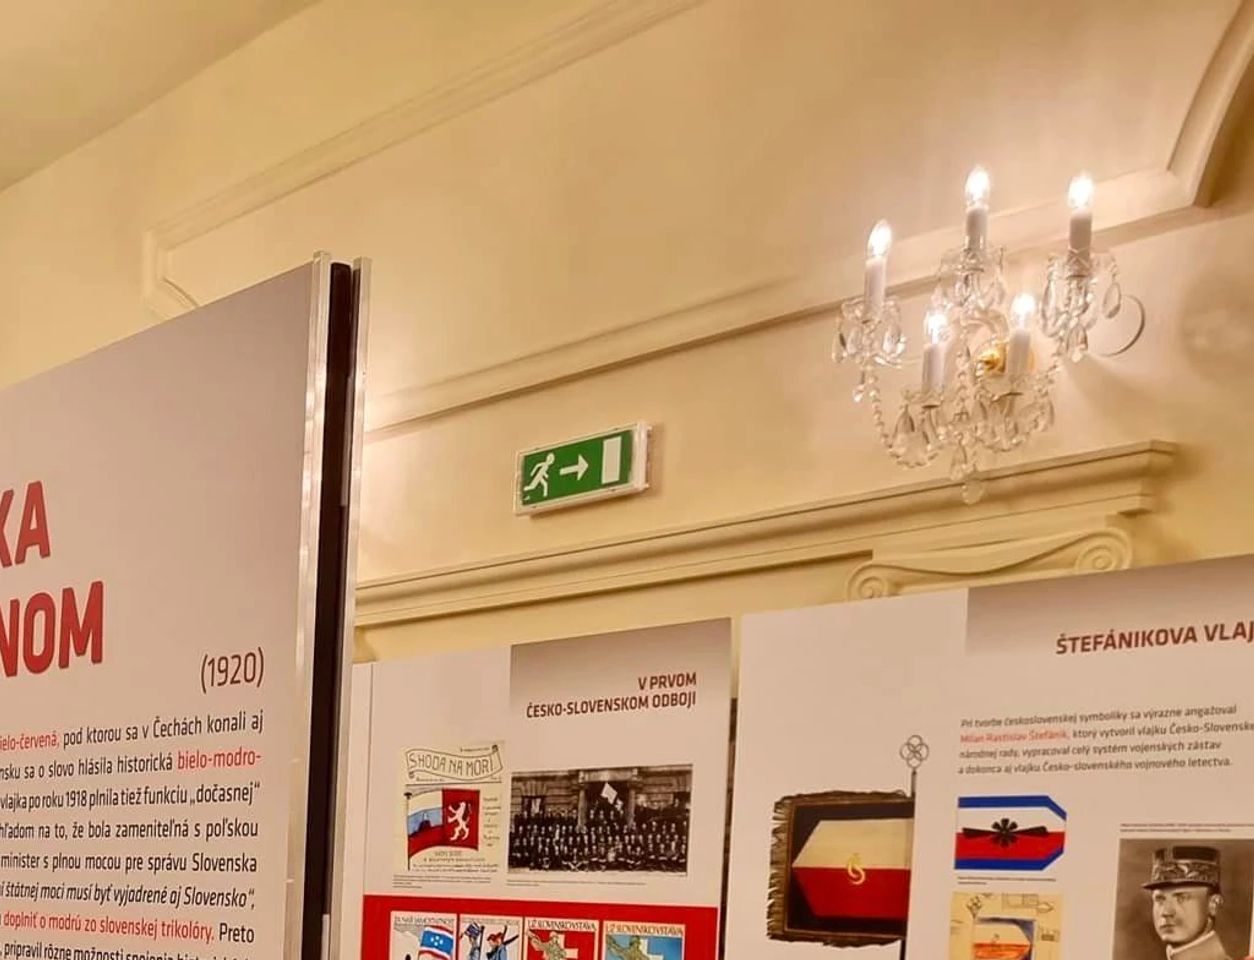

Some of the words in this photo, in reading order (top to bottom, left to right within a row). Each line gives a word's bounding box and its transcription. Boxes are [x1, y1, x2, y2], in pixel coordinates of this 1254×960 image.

[1056, 626, 1197, 654] ŠTEFÁNIKOVA
[200, 647, 266, 693] (1920)
[638, 677, 647, 690] V
[650, 672, 696, 689] PRVOM
[526, 695, 648, 718] ČESKO-SLOVENSKOM
[652, 691, 696, 709] ODBOJI
[64, 729, 82, 749] pod
[87, 727, 121, 743] ktorou
[126, 726, 137, 740] sa
[142, 725, 149, 738] v
[153, 716, 202, 737] Čechách
[207, 711, 245, 733] konali
[252, 709, 263, 733] aj
[24, 765, 34, 779] sa
[48, 760, 74, 777] slovo
[78, 758, 112, 775] hlásila
[118, 752, 173, 773] historická
[178, 747, 261, 770] bielo-modro-
[409, 752, 446, 771] SHODA
[449, 759, 463, 774] NA
[0, 793, 27, 809] vlajka
[29, 796, 40, 812] po
[42, 791, 63, 809] roku
[66, 790, 87, 807] 1918
[89, 789, 118, 810] plnila
[121, 787, 141, 805] tiež
[144, 785, 187, 804] funkciu
[190, 781, 260, 806] „dočasnej“
[39, 825, 50, 838] na
[55, 823, 67, 839] to,
[72, 822, 84, 837] že
[88, 820, 111, 838] bola
[115, 819, 188, 837] zameniteľná
[206, 817, 258, 842] poľskou
[1, 852, 39, 869] minister
[52, 853, 80, 873] plnou
[85, 856, 120, 869] mocou
[125, 855, 142, 875] pre
[148, 853, 186, 875] správu
[192, 853, 257, 872] Slovenska
[41, 883, 64, 899] moci
[67, 884, 92, 900] musí
[95, 883, 112, 905] byť
[114, 885, 167, 907] vyjadrené
[170, 886, 180, 908] aj
[48, 914, 81, 931] modrú
[85, 918, 96, 931] zo
[100, 916, 157, 940] slovenskej
[162, 921, 214, 944] trikolóry.
[219, 923, 254, 943] Preto
[4, 942, 42, 960] pripravil
[44, 944, 71, 960] rôzne
